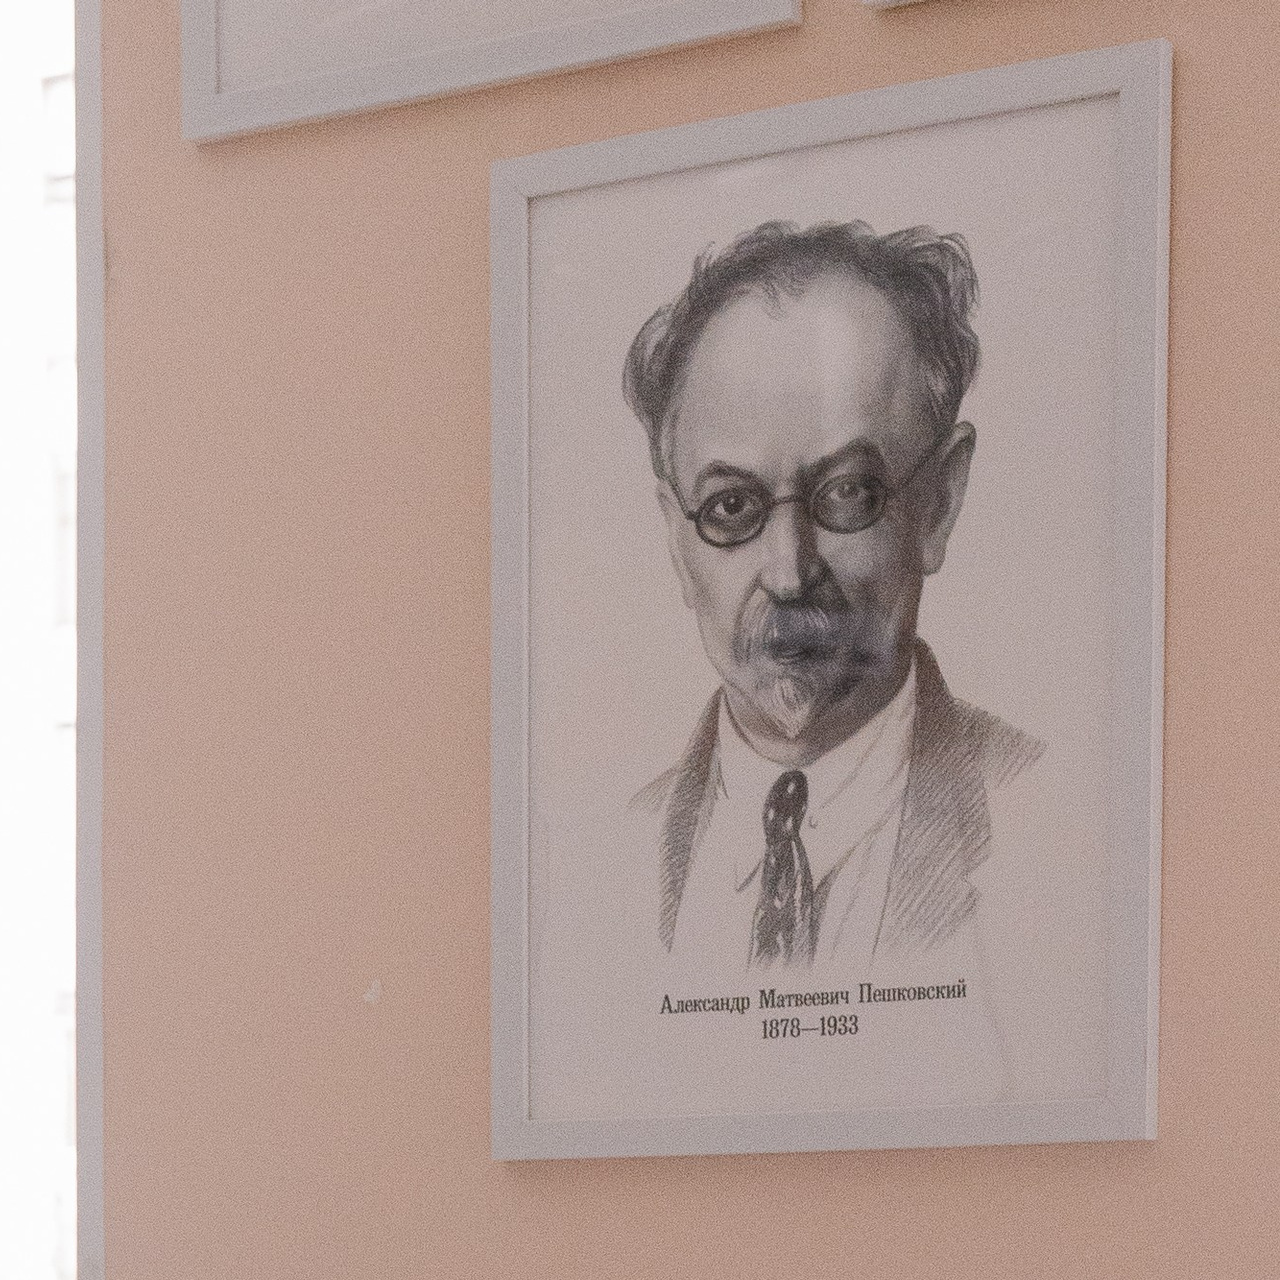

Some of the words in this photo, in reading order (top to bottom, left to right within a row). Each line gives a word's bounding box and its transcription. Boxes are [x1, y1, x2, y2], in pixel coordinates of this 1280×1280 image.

[660, 993, 750, 1015] Александр
[758, 987, 851, 1010] Матвеевич
[858, 979, 968, 1003] Пешковский
